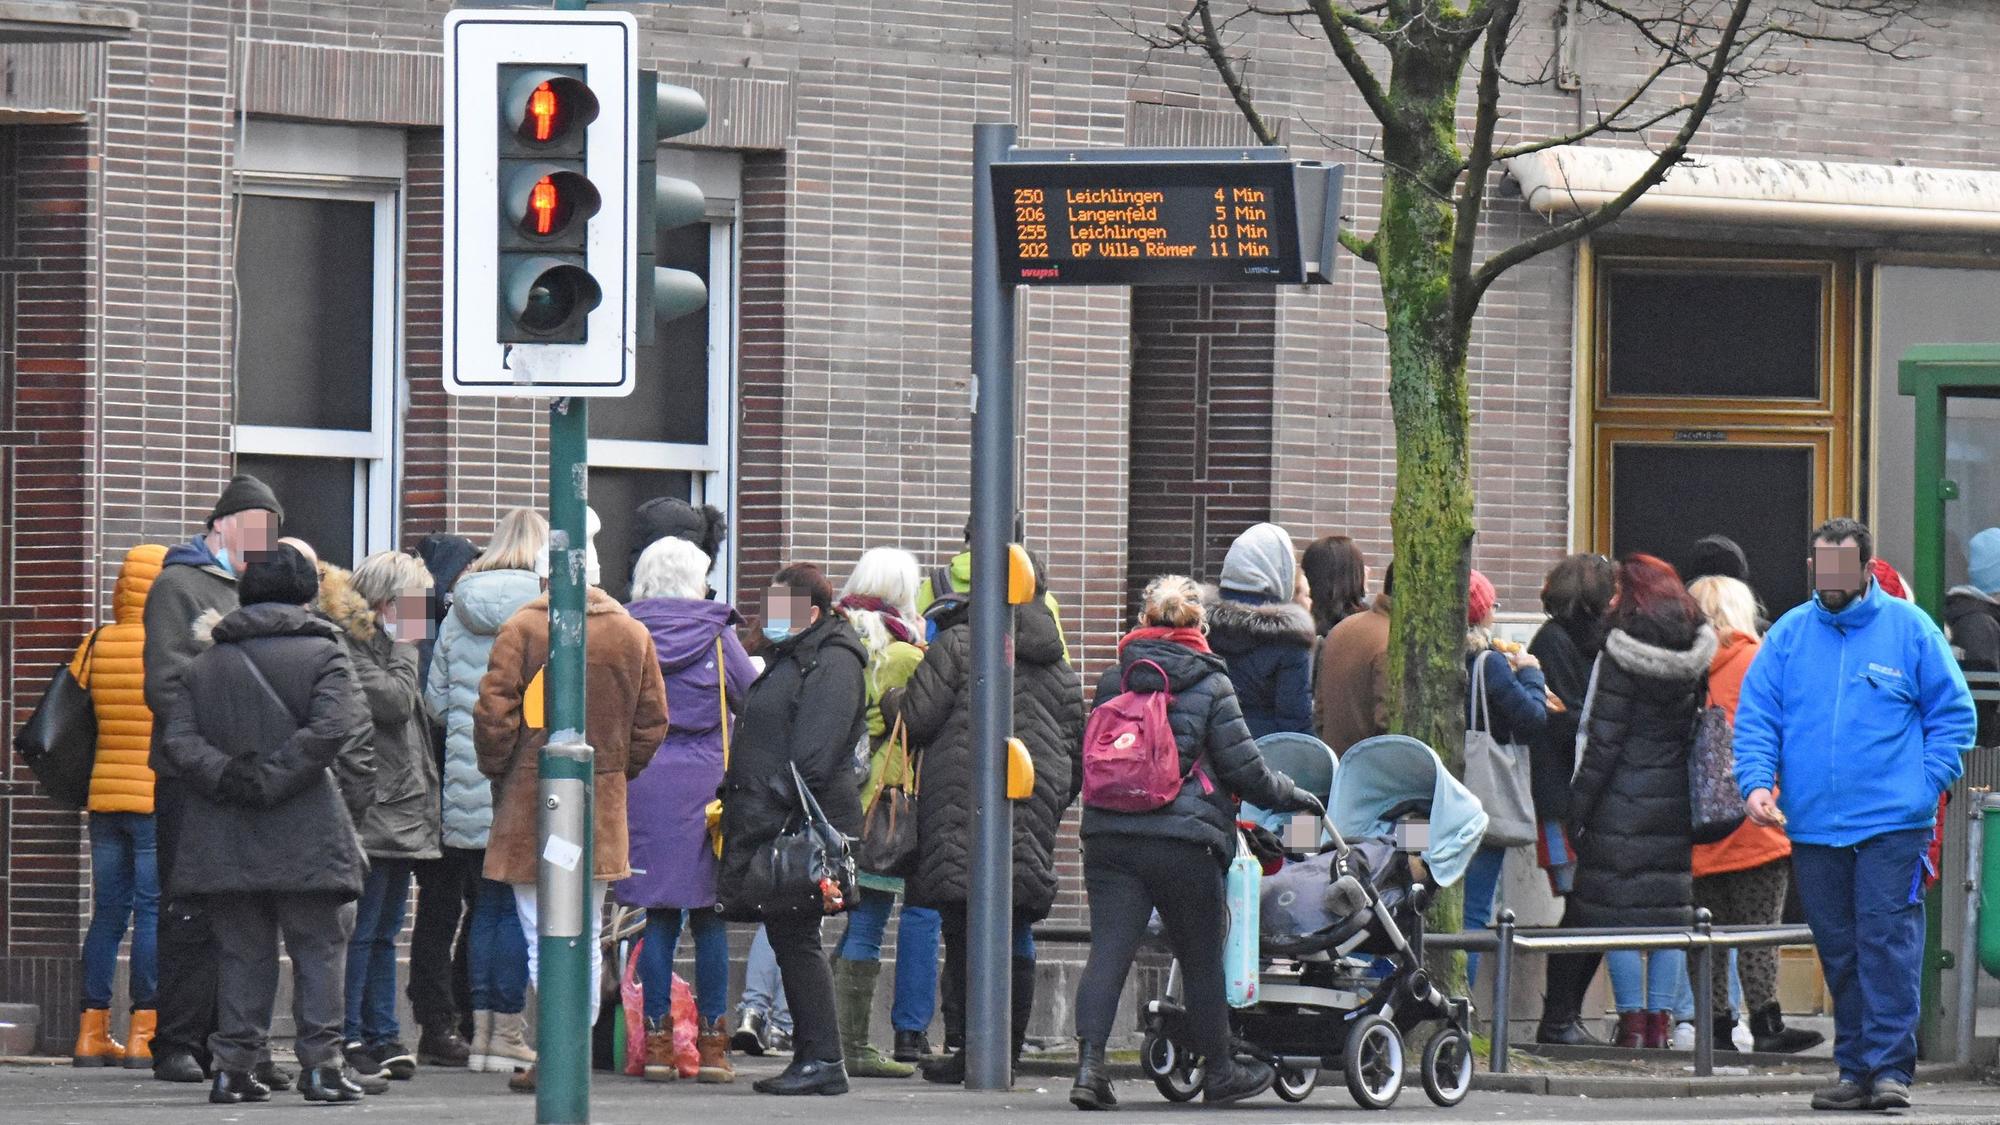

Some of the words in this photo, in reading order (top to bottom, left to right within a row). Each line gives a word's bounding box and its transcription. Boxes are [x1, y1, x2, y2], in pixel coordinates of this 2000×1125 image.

[1014, 188, 1044, 205] 250
[1066, 188, 1164, 206] Leichlingen
[1214, 187, 1225, 202] 4
[1232, 187, 1265, 203] Min
[1016, 206, 1046, 222] 206
[1068, 205, 1158, 225] Langenfeld
[1215, 205, 1227, 221] 5
[1234, 205, 1266, 221] Min
[1017, 224, 1048, 241] 255
[1069, 224, 1167, 243] Leichlingen
[1209, 223, 1229, 239] 10
[1236, 223, 1268, 239] Min
[1019, 242, 1049, 258] 202
[1098, 242, 1140, 258] Villa
[1145, 241, 1197, 258] Römer
[1211, 241, 1229, 257] 11
[1238, 241, 1270, 257] Min
[1021, 264, 1059, 279] wupsi
